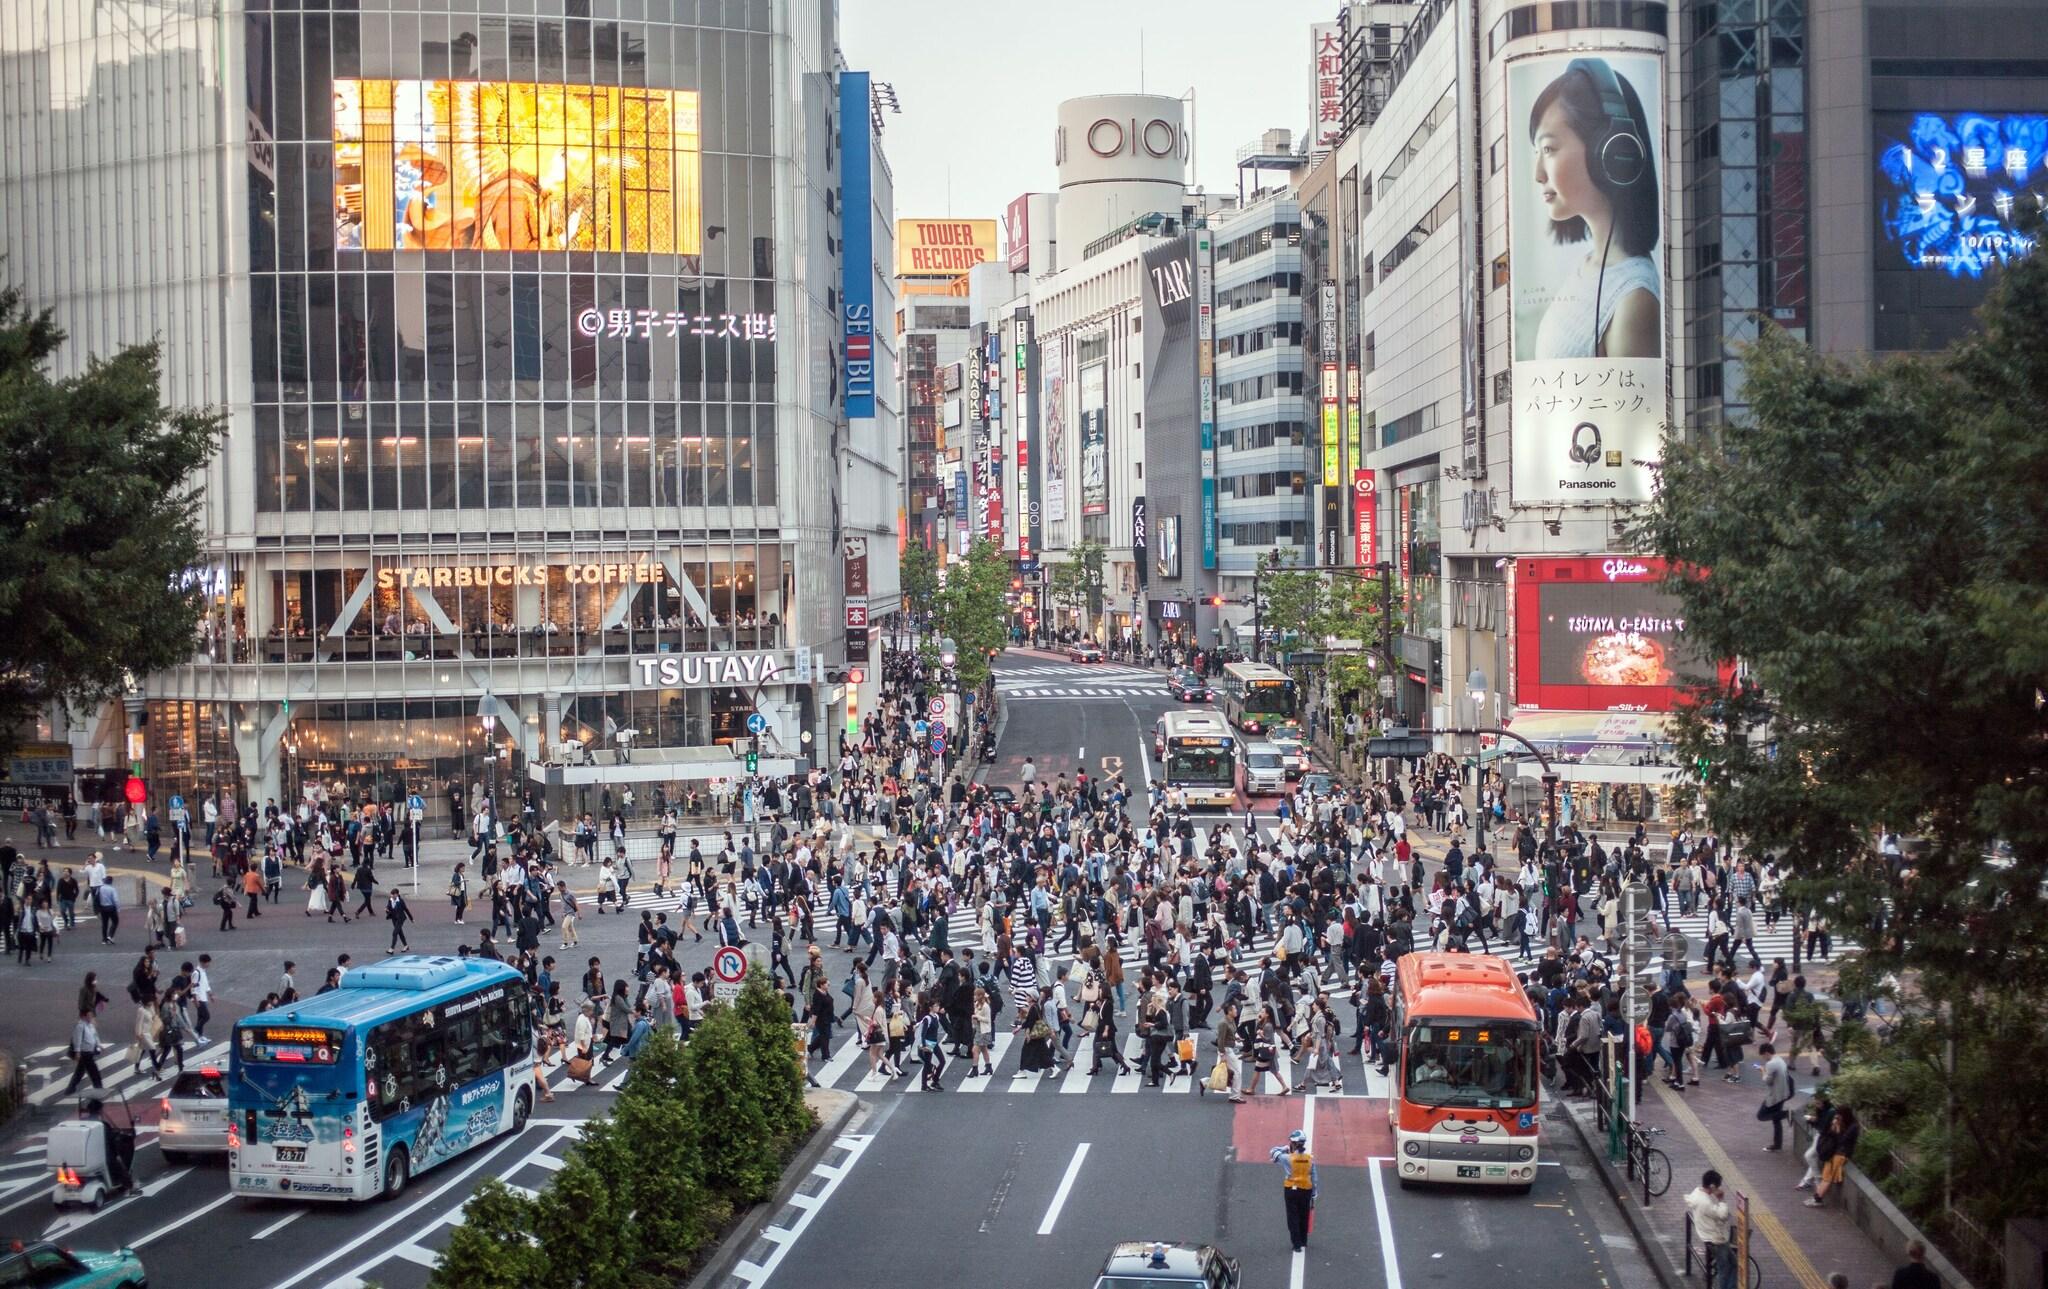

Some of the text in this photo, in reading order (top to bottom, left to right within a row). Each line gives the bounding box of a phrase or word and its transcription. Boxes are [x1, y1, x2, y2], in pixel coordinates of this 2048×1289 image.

[917, 223, 974, 246] TOWER
[912, 247, 985, 270] RECORDS
[846, 303, 872, 397] SEIBU
[969, 349, 981, 420] KARAOKE
[1531, 368, 1646, 390] ハイレゾは、
[1526, 394, 1652, 415] パナソニック。
[1559, 479, 1616, 489] Panasonic
[1135, 504, 1146, 548] ZARA
[378, 562, 664, 588] STARBUCKS COFFEE
[849, 609, 864, 624] 本
[1162, 602, 1180, 618] ZARA
[638, 655, 780, 686] TSUTAYA
[717, 987, 738, 996] ここか
